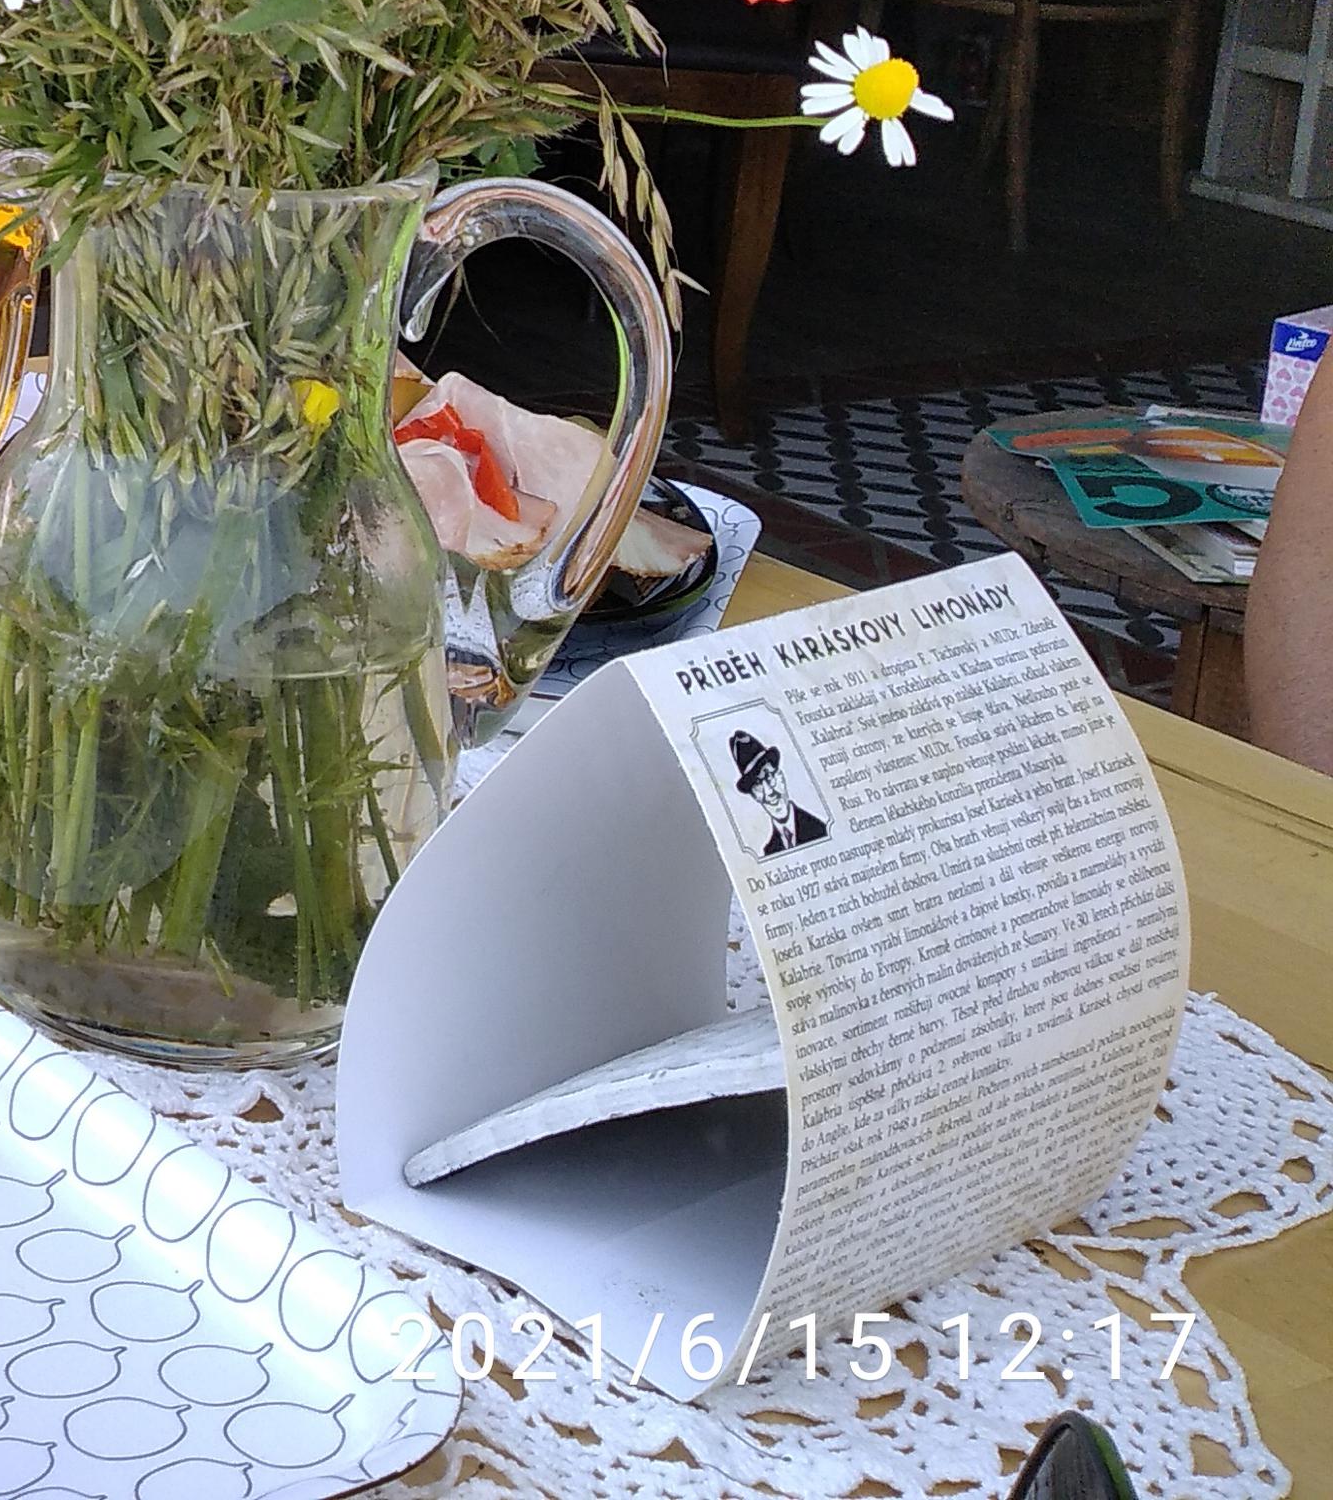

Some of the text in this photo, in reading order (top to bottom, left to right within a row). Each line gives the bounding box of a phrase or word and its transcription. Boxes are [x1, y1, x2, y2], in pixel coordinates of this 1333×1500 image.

[675, 583, 1016, 696] PŘÍBĚH KARÁSKOVY LIMONÁDY
